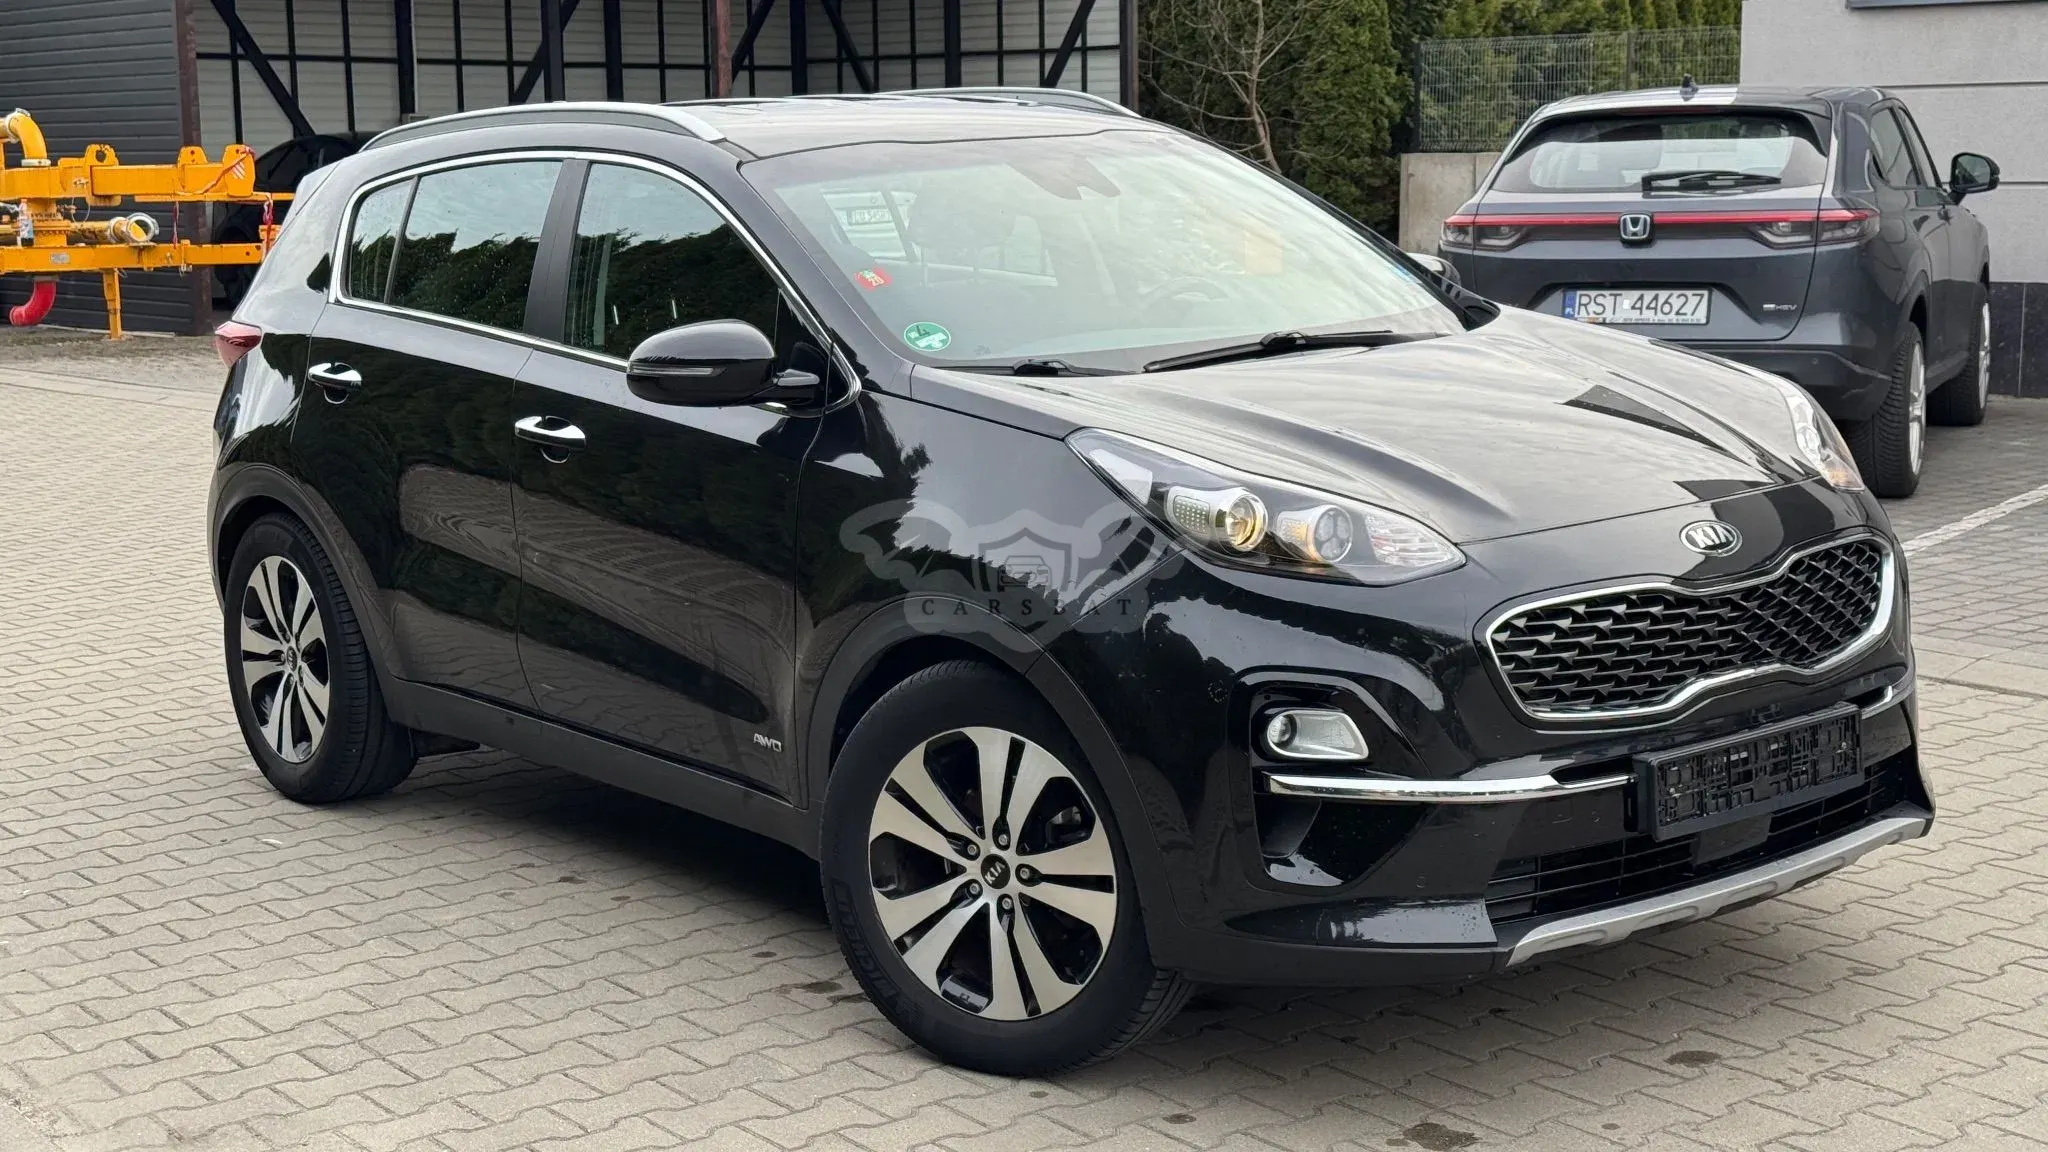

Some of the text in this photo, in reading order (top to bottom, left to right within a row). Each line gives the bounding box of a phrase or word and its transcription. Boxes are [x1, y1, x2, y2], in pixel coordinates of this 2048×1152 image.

[1577, 292, 1705, 316] RST 44627
[916, 325, 930, 336] 4
[1687, 524, 1733, 549] KIA
[753, 733, 782, 752] AWD
[984, 861, 1006, 886] KIA
